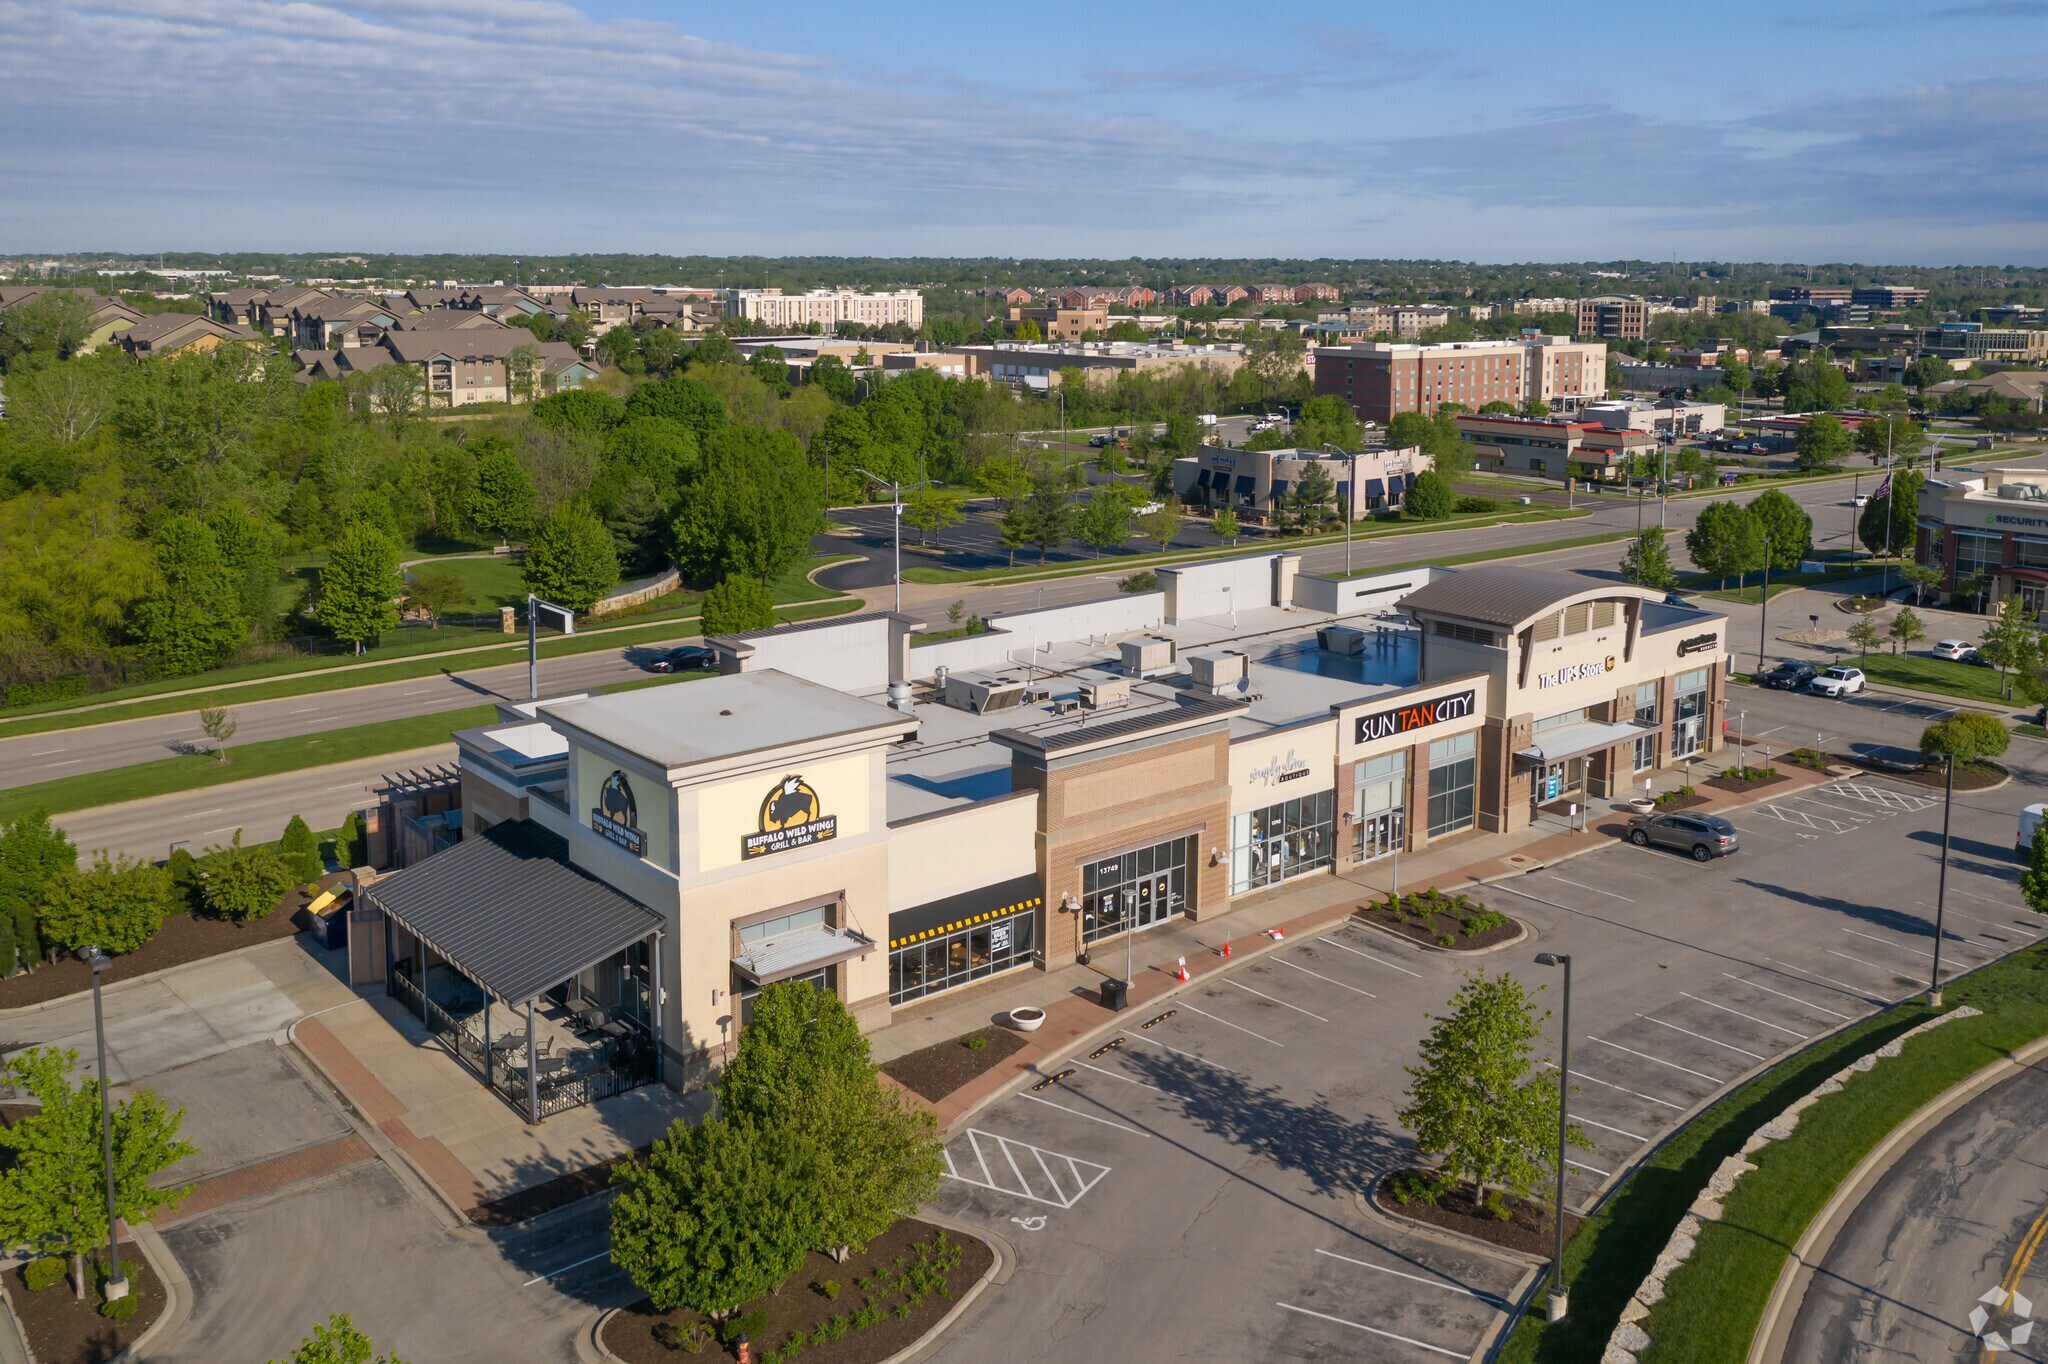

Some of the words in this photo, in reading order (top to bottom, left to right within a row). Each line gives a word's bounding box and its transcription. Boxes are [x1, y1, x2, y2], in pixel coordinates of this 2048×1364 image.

[1538, 672, 1557, 690] The
[1558, 666, 1578, 684] UPS
[1579, 662, 1604, 680] Store
[1362, 713, 1396, 742] SUN
[1398, 703, 1435, 732] TAN
[1435, 692, 1472, 722] CITY
[1280, 770, 1309, 782] BOUTIQUE
[612, 822, 624, 837] WILD
[747, 831, 784, 848] BUFFALO
[786, 825, 807, 839] WILD
[808, 819, 834, 833] WINGS
[770, 840, 789, 851] GRILL
[790, 838, 797, 846] &
[797, 834, 812, 845] BAR
[1100, 864, 1119, 875] 13749
